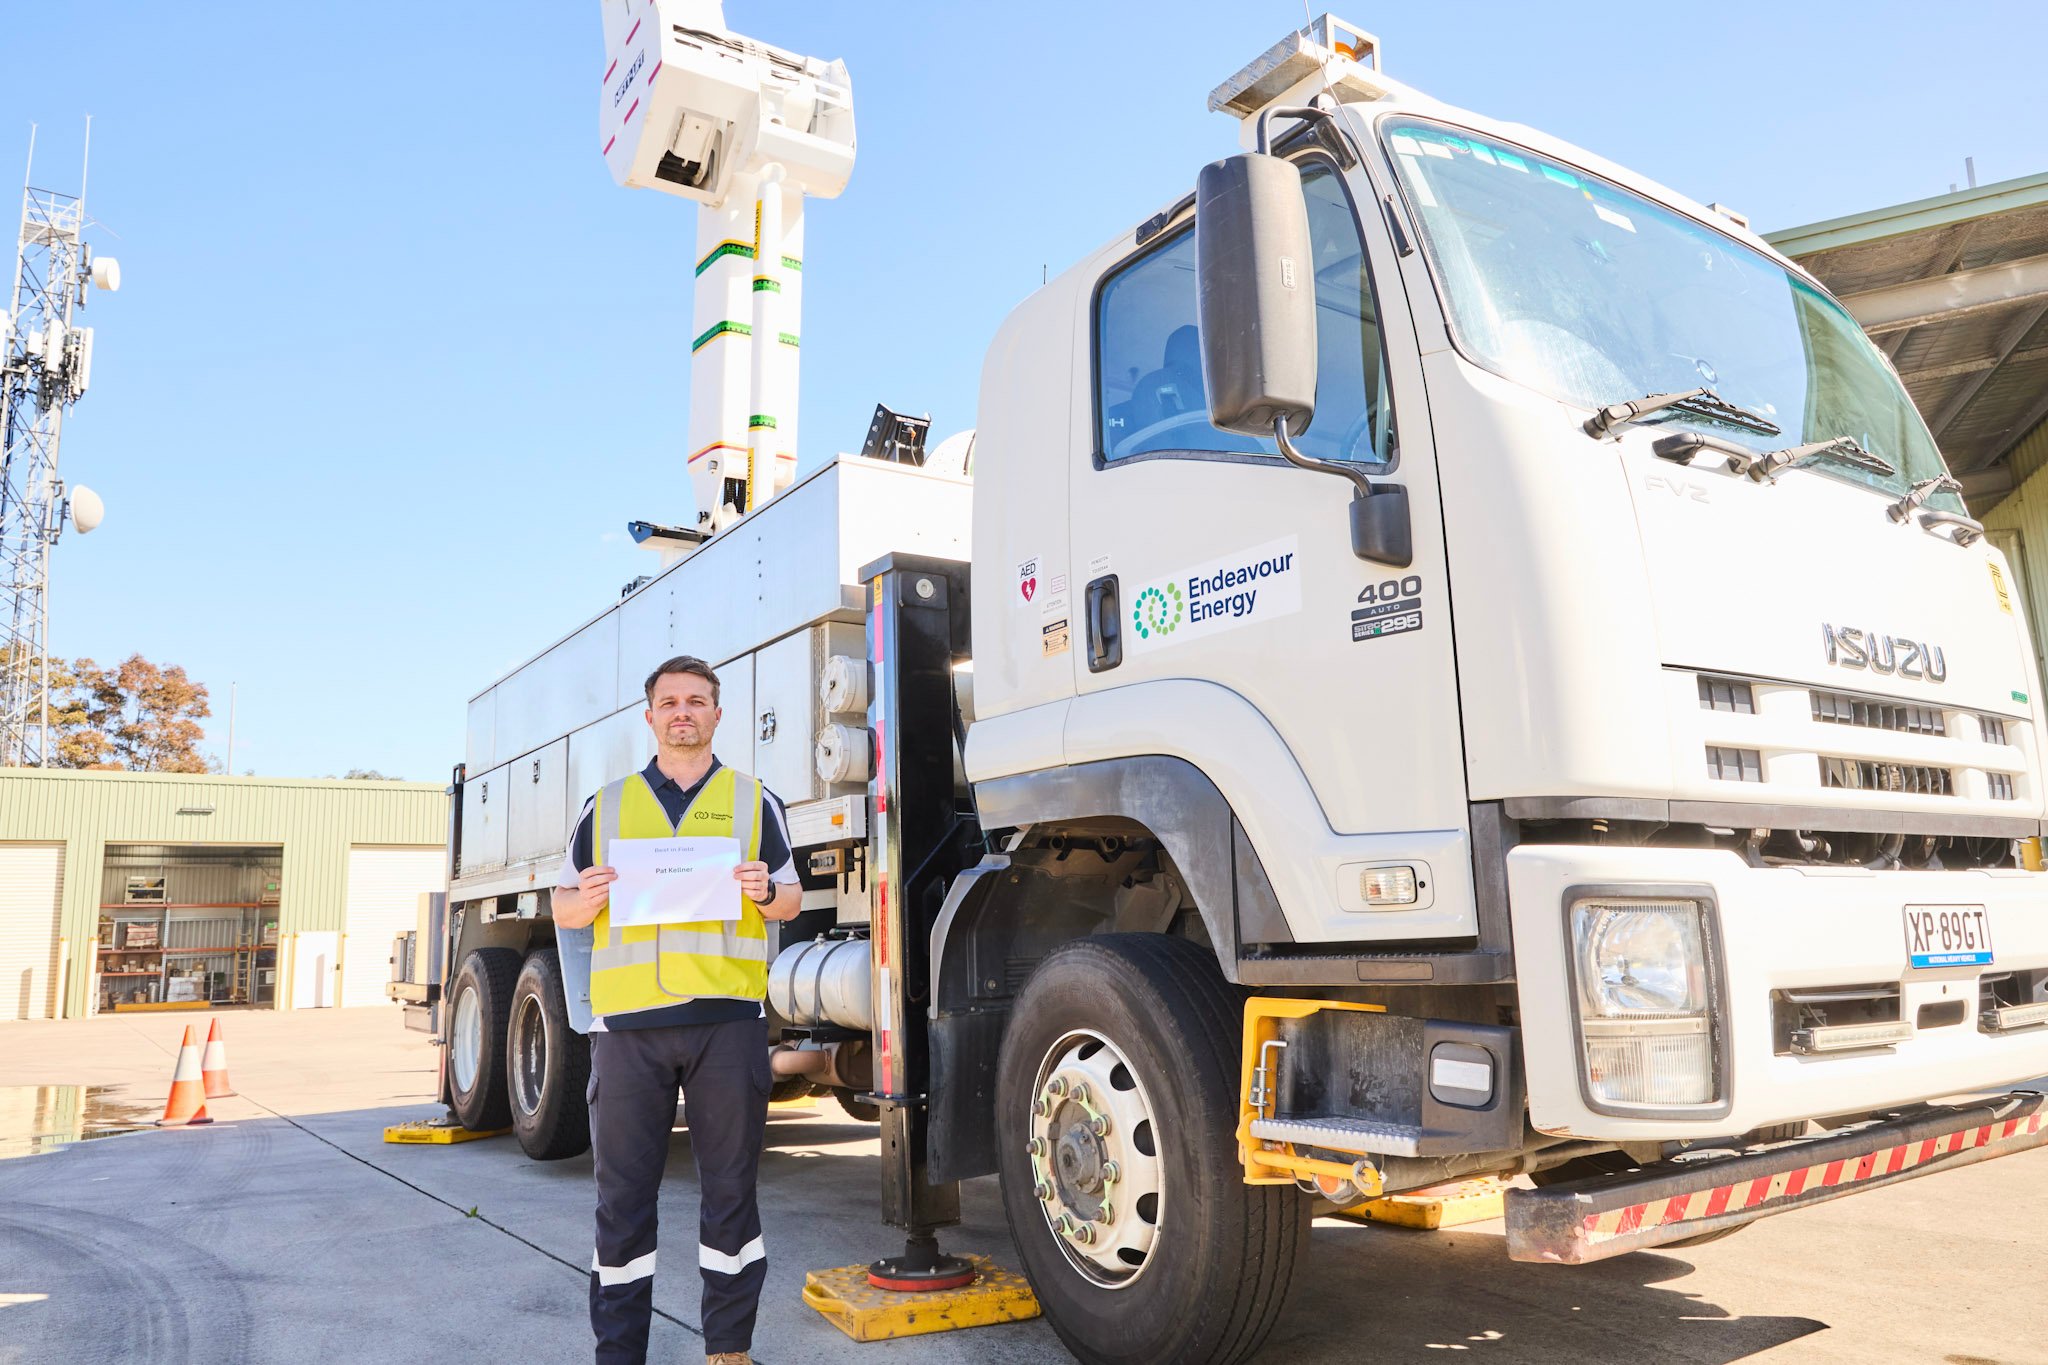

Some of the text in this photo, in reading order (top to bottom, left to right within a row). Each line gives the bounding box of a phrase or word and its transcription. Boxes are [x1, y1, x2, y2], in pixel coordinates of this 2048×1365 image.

[1644, 475, 1710, 504] FVZ
[1020, 562, 1036, 579] AED
[1188, 552, 1293, 599] Endeavour
[1357, 575, 1422, 604] 400
[1189, 589, 1257, 623] Energy
[1370, 604, 1400, 615] AUTO
[1381, 613, 1420, 633] 295
[1821, 622, 1947, 684] ISUZU
